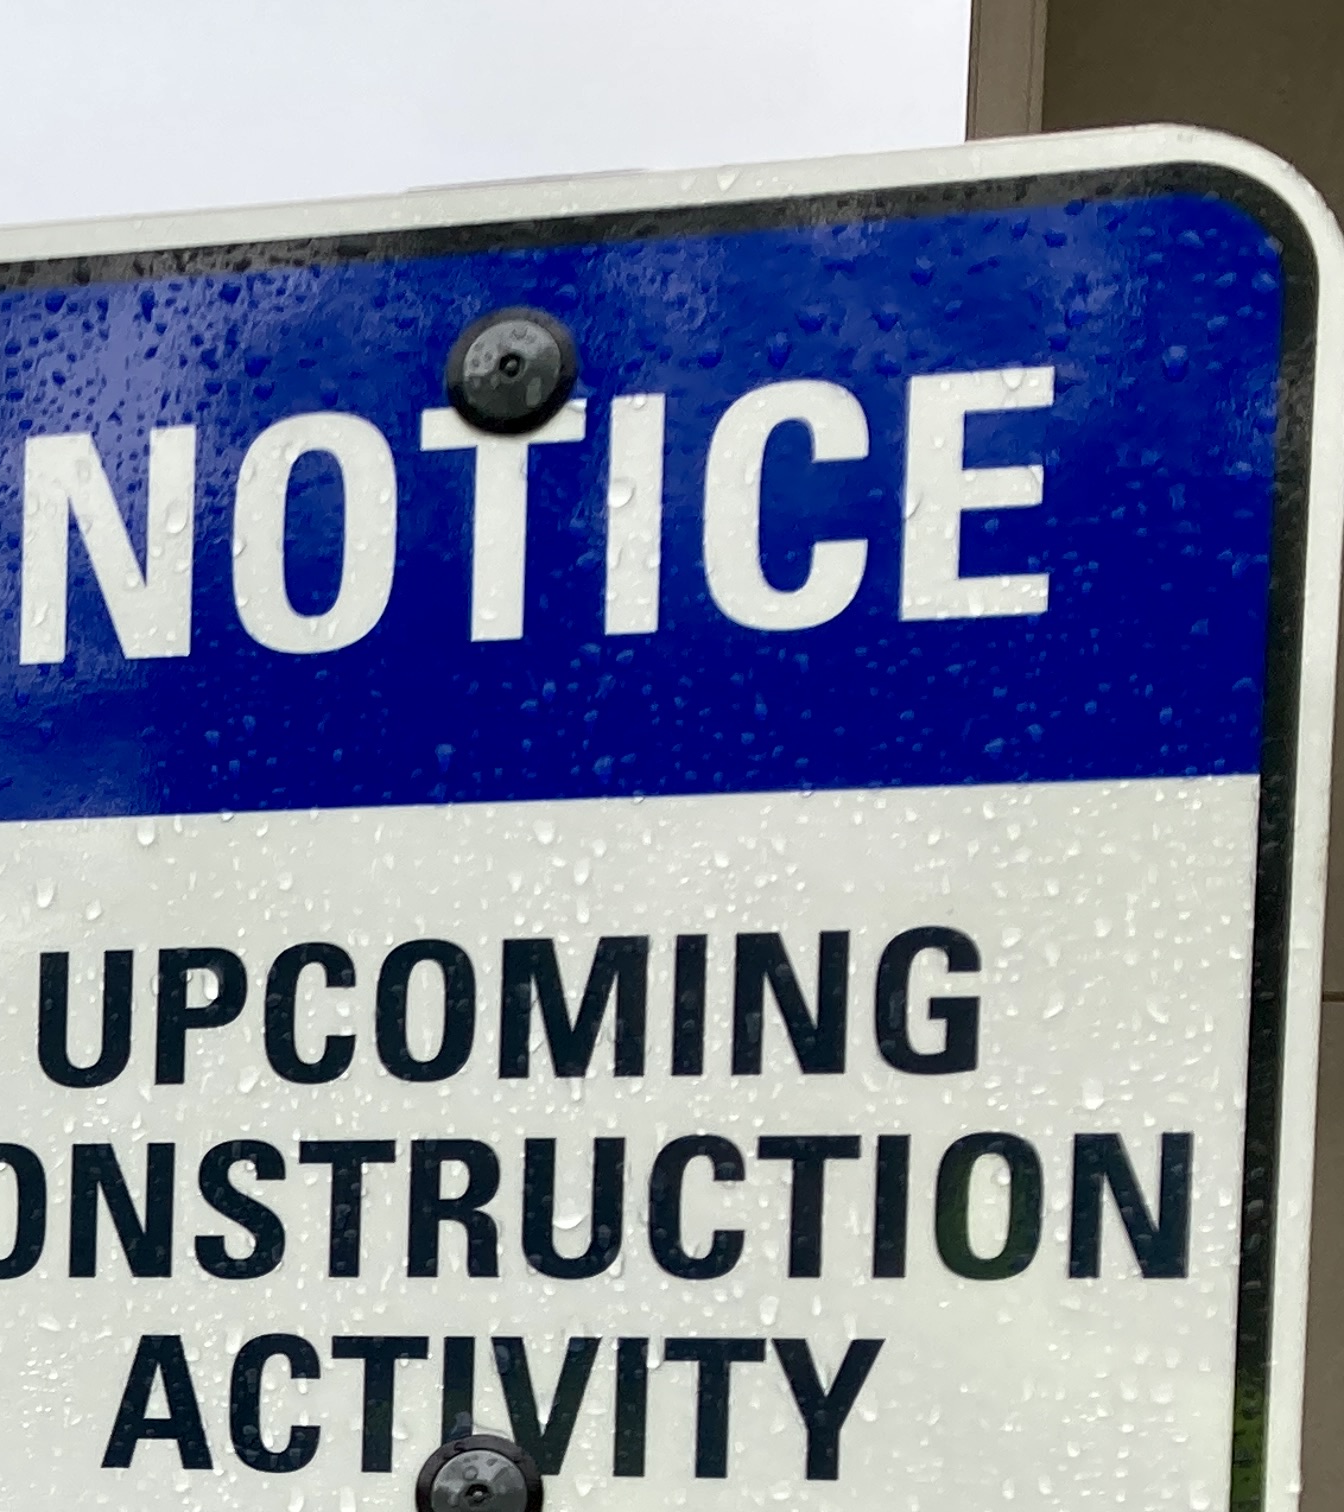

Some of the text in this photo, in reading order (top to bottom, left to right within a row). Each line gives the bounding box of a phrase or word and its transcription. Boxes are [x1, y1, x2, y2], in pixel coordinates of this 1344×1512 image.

[20, 367, 1054, 664] NOTICE
[37, 926, 981, 1089] UPCOMING
[100, 1333, 885, 1481] ACTIVITY
